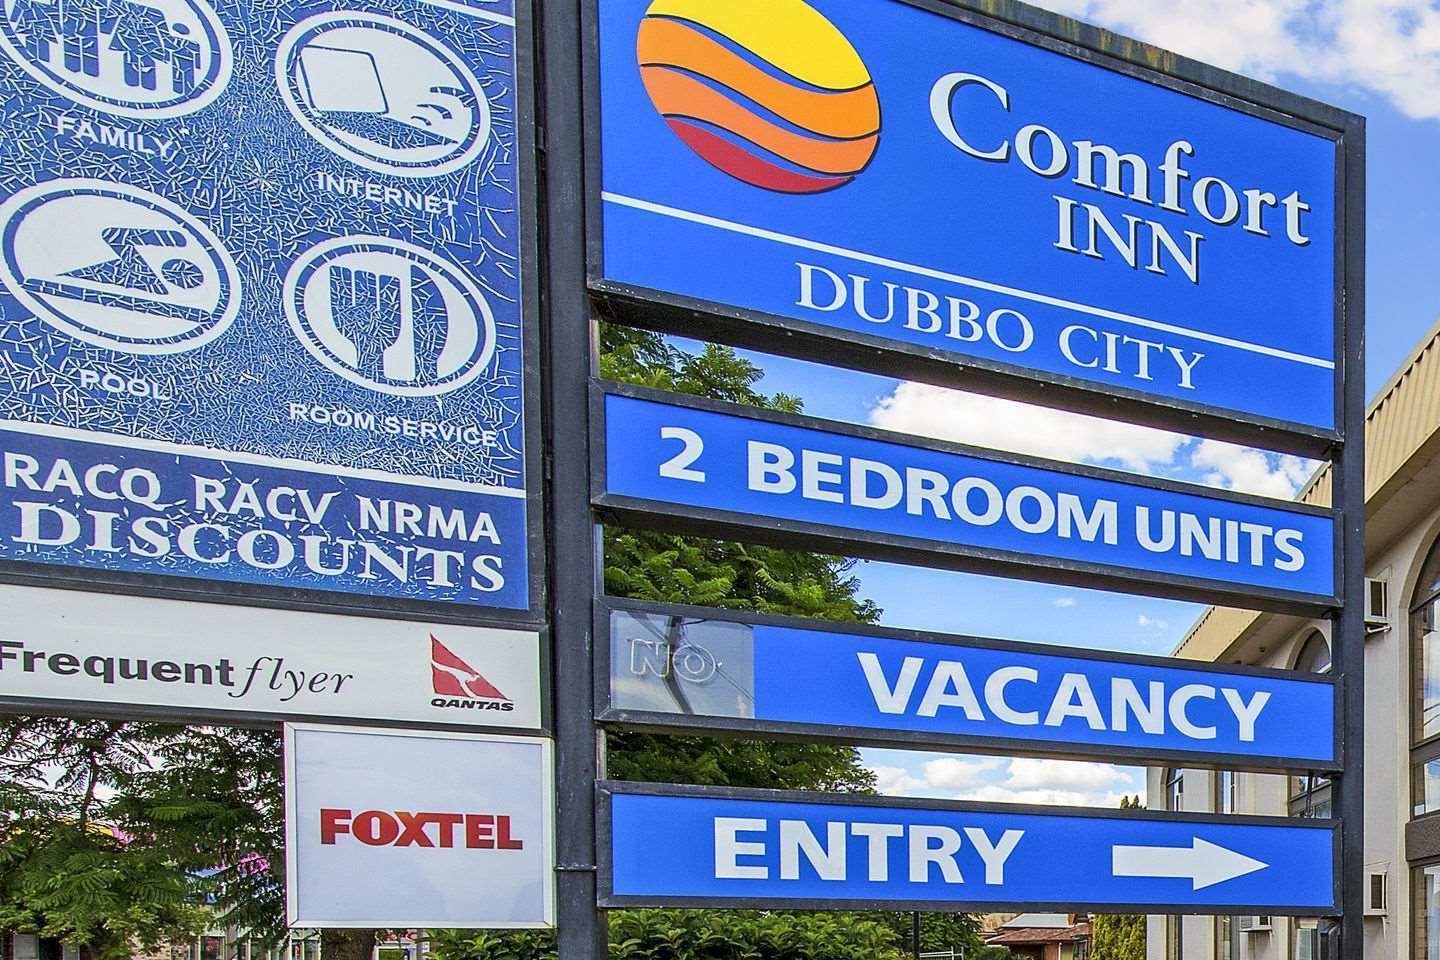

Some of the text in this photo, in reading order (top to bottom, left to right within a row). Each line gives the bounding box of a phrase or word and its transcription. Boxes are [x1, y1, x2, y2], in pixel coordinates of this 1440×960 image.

[56, 115, 176, 162] FAMILY
[929, 72, 1311, 246] Comfort
[316, 171, 458, 217] INTERNET
[1053, 195, 1204, 284] INN
[795, 262, 1205, 391] DUBBO CITY
[80, 369, 172, 400] POOL
[289, 403, 498, 447] ROOM SERVICE
[4, 452, 501, 545] RACQ RACV NRMA
[658, 427, 1305, 572] 2 BEDROOM UNITS
[12, 500, 505, 592] DISCOUNTS
[228, 657, 353, 701] flyer
[430, 698, 515, 712] QANTAS
[630, 638, 1272, 742] NO VACANCY
[320, 808, 523, 850] FOXTEL
[714, 817, 1025, 885] ENTRY
